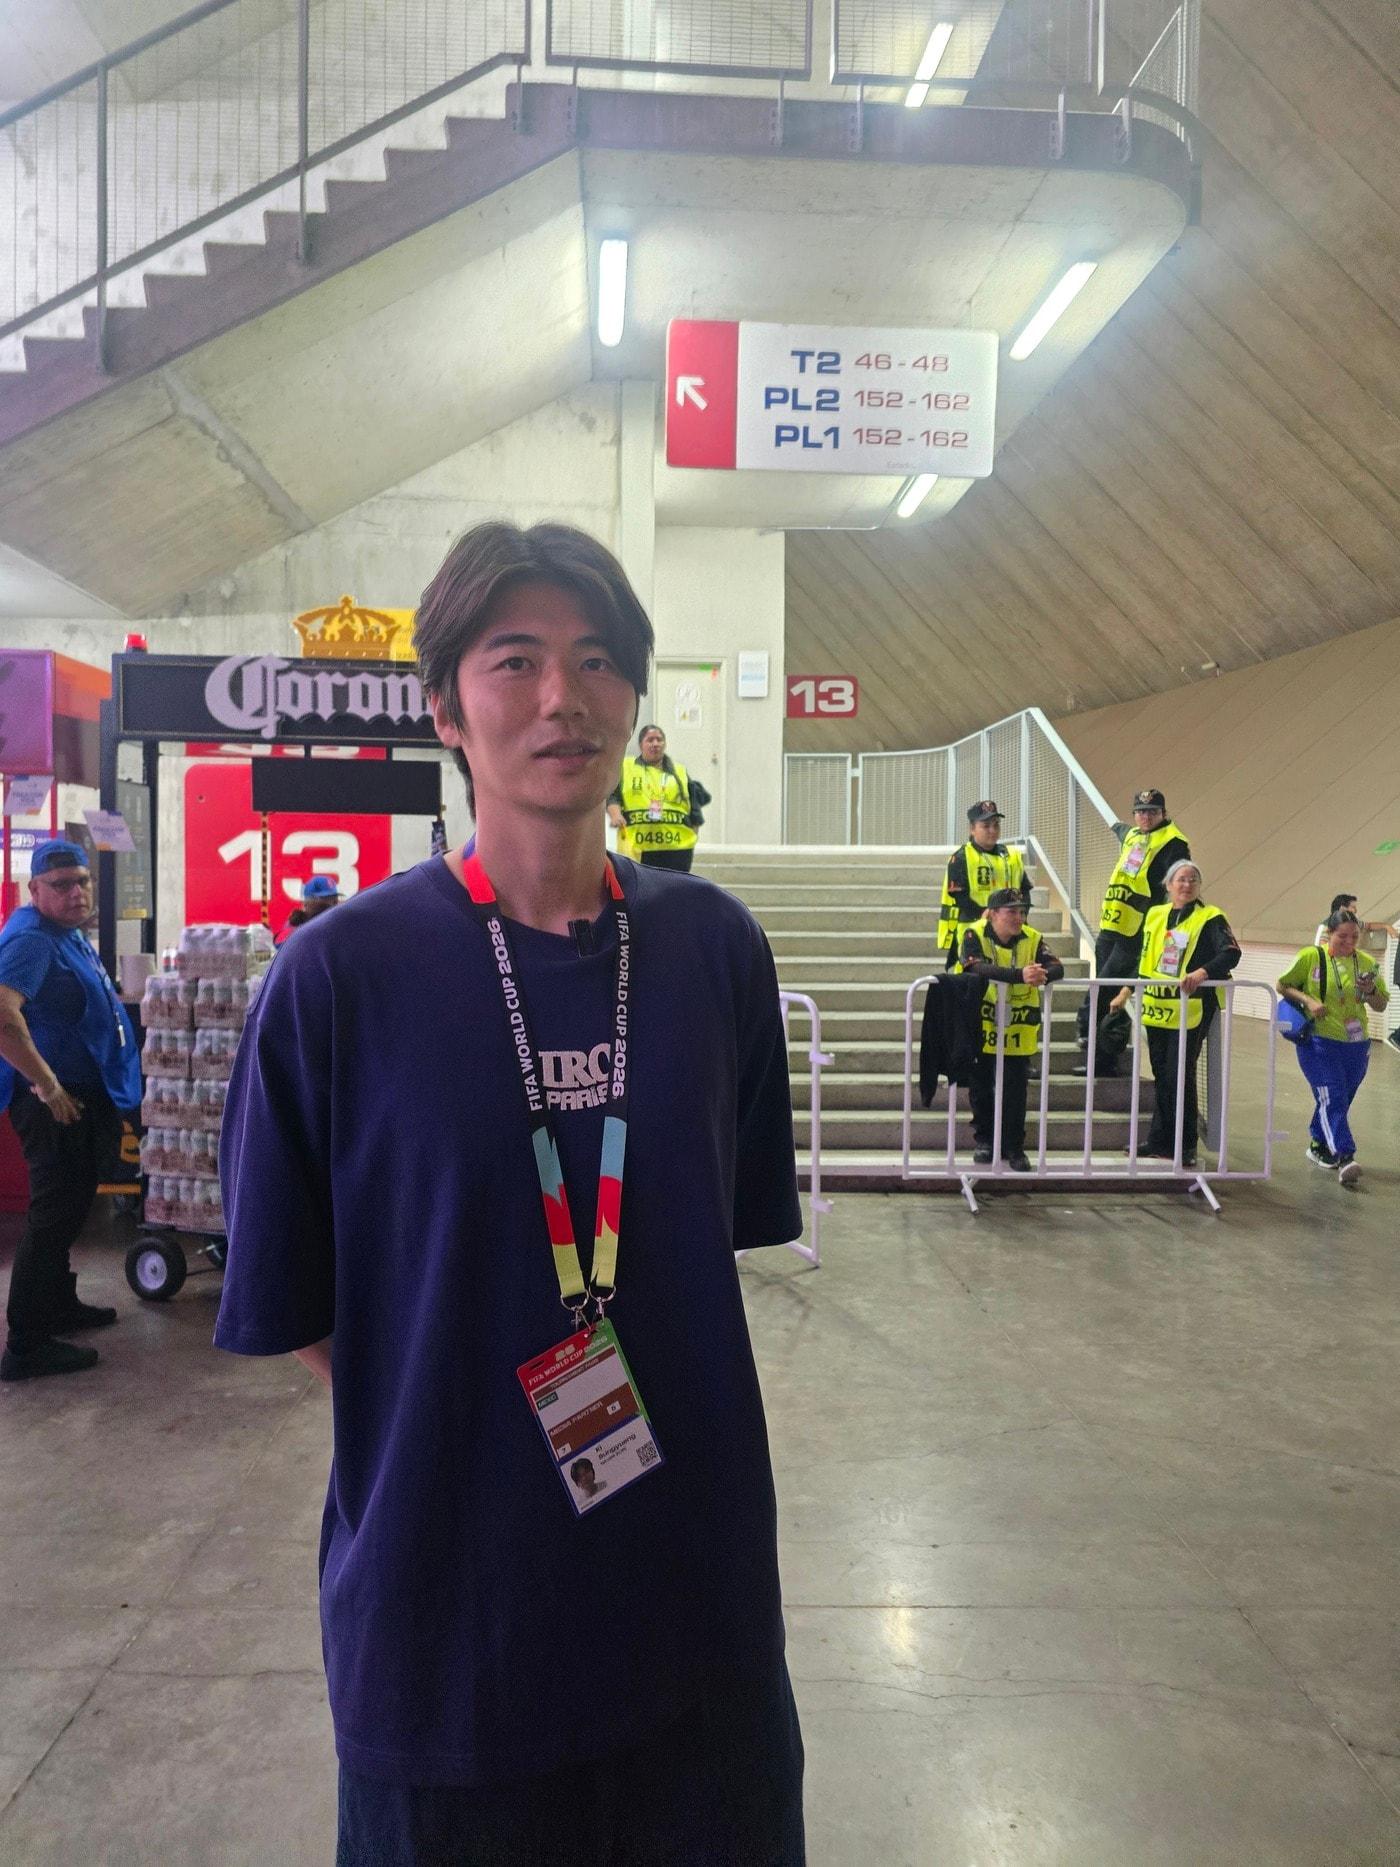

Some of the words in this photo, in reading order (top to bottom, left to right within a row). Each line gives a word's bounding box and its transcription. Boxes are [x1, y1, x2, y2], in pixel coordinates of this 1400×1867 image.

[791, 350, 841, 375] T2
[764, 387, 840, 412] PL2
[774, 425, 840, 449] PL1
[205, 654, 434, 739] Coron
[790, 679, 855, 713] 13
[629, 810, 685, 824] SECRITY
[635, 831, 682, 845] 04894
[217, 829, 361, 902] 13
[616, 911, 629, 942] FIFA
[487, 918, 512, 975] 2026
[618, 943, 629, 1001] WORLD
[502, 977, 520, 1010] CUP
[616, 1004, 628, 1036] CUP
[510, 1012, 535, 1072] WORLD
[612, 1038, 627, 1098] 2026
[524, 1074, 543, 1111] FIFA
